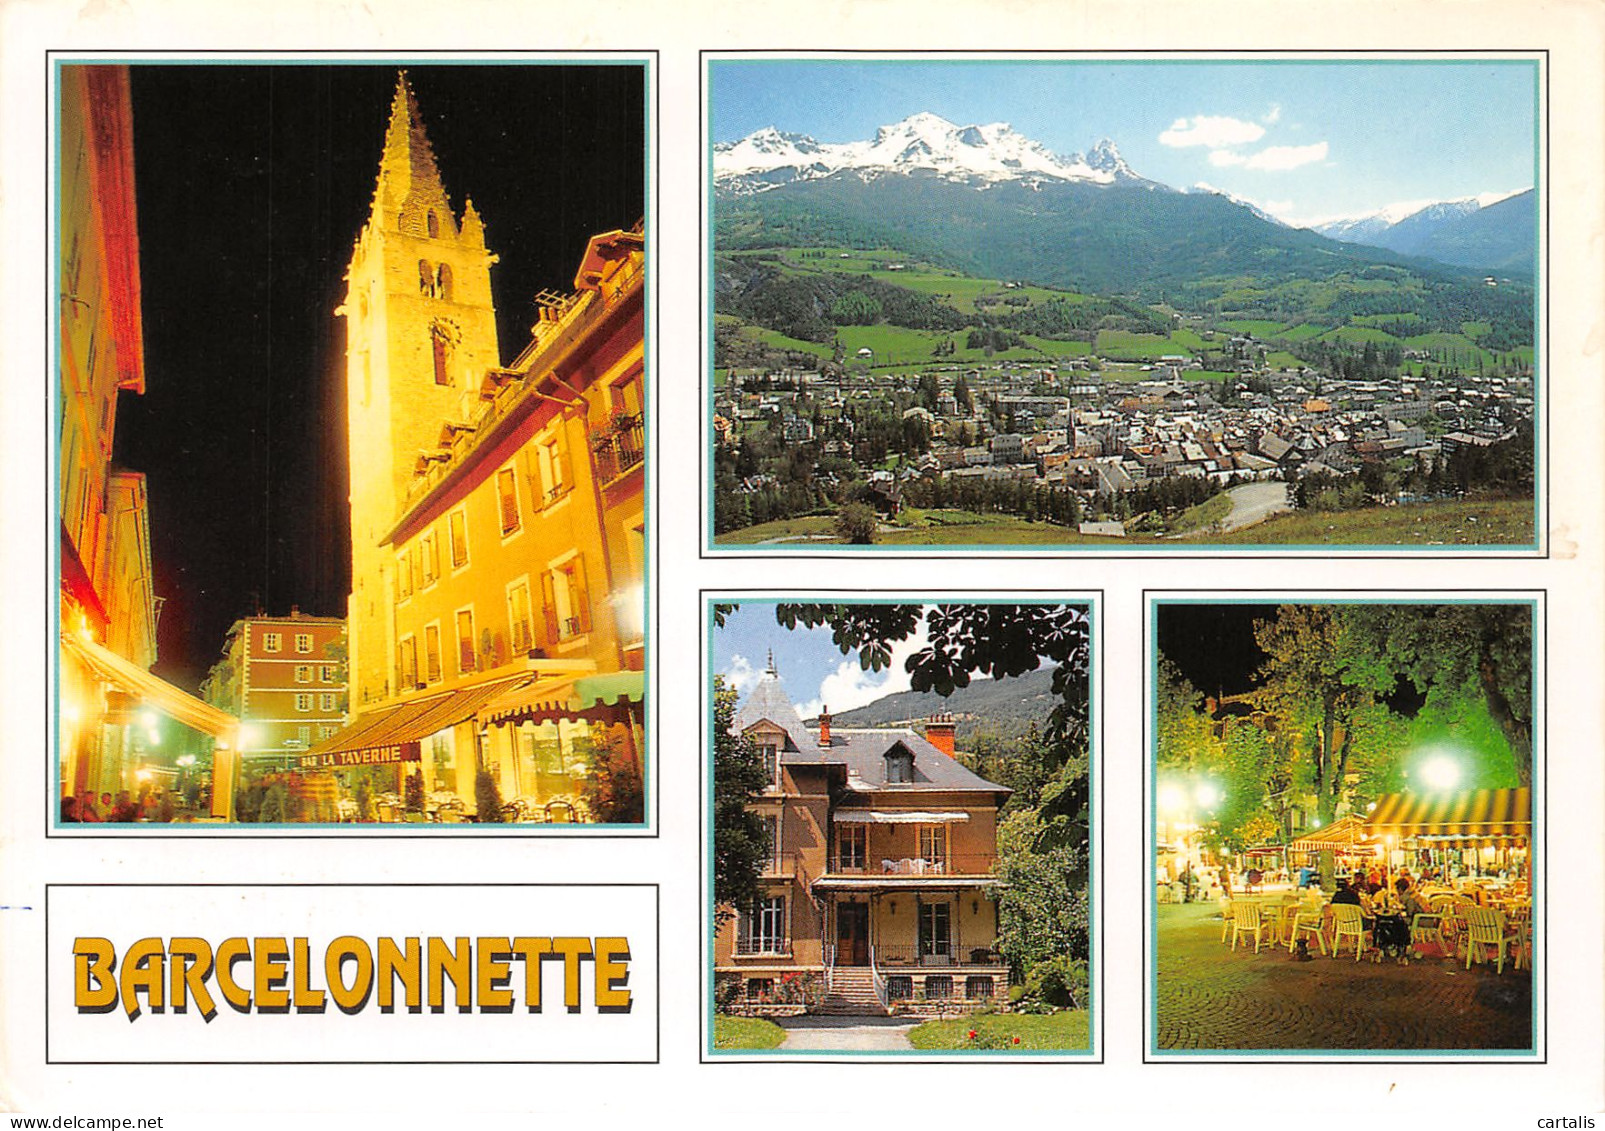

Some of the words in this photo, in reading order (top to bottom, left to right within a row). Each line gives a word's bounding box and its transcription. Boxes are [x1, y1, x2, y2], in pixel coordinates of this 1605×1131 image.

[323, 754, 335, 765] LA
[340, 746, 401, 764] TAVERNE
[72, 935, 634, 1024] BARCELONNETTE
